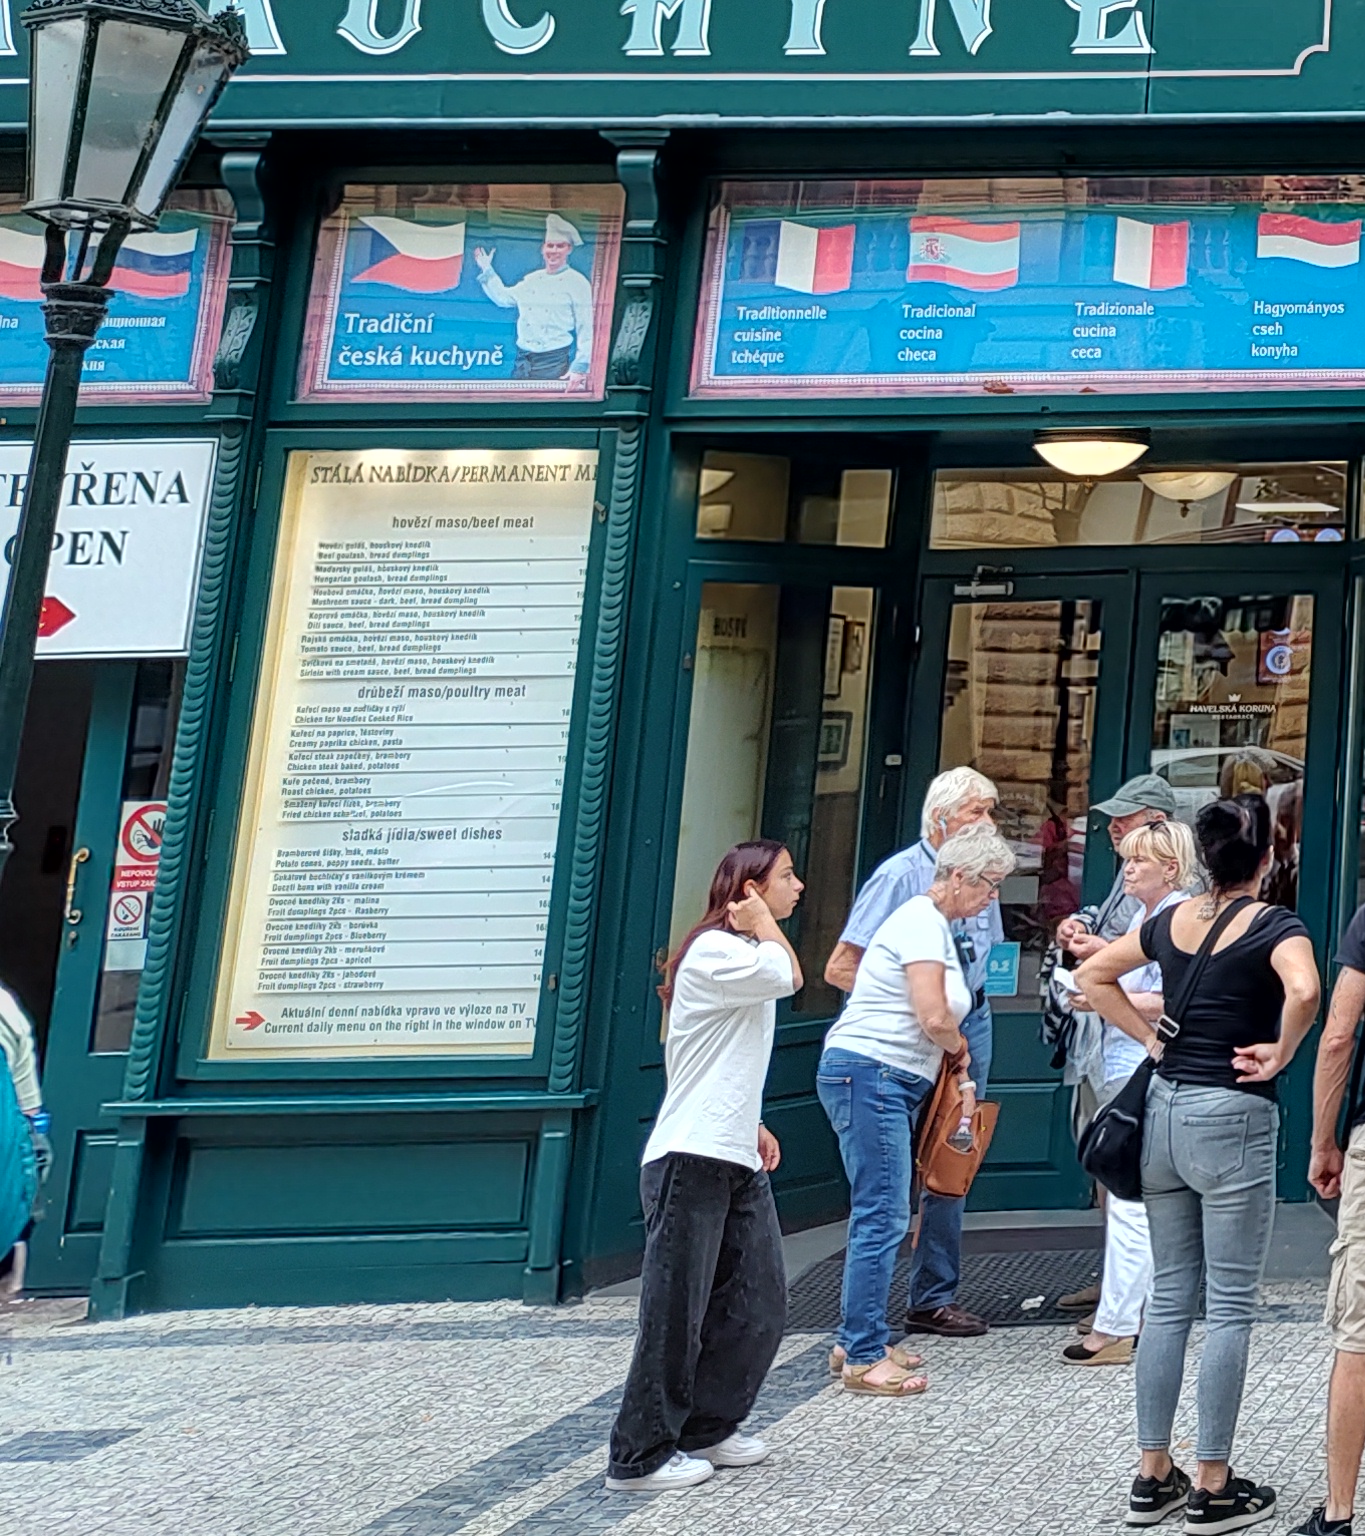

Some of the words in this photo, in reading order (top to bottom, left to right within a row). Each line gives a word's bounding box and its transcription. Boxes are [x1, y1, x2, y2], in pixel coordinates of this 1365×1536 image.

[736, 305, 827, 321] Traditionnelle
[902, 303, 976, 319] Tradicional
[1075, 301, 1155, 316] Tradizionale
[1253, 300, 1345, 318] Hagyományos
[344, 312, 435, 334] Tradiční
[1252, 323, 1283, 336] cseh
[733, 328, 782, 342] cuisine
[899, 327, 943, 340] cocina
[1073, 324, 1116, 338] cucina
[338, 345, 403, 366] česká
[410, 344, 504, 370] kuchyně
[897, 348, 936, 362] checa
[1071, 347, 1102, 359] ceca
[1251, 343, 1298, 359] konyha
[264, 1020, 304, 1033] Current
[306, 1021, 333, 1033] daily
[336, 1022, 365, 1032] menu
[368, 1022, 382, 1031] on
[384, 1020, 401, 1031] the
[404, 1019, 429, 1032] right
[432, 1019, 442, 1030] in
[445, 1019, 461, 1030] the
[465, 1018, 505, 1029] window
[508, 1019, 521, 1029] on
